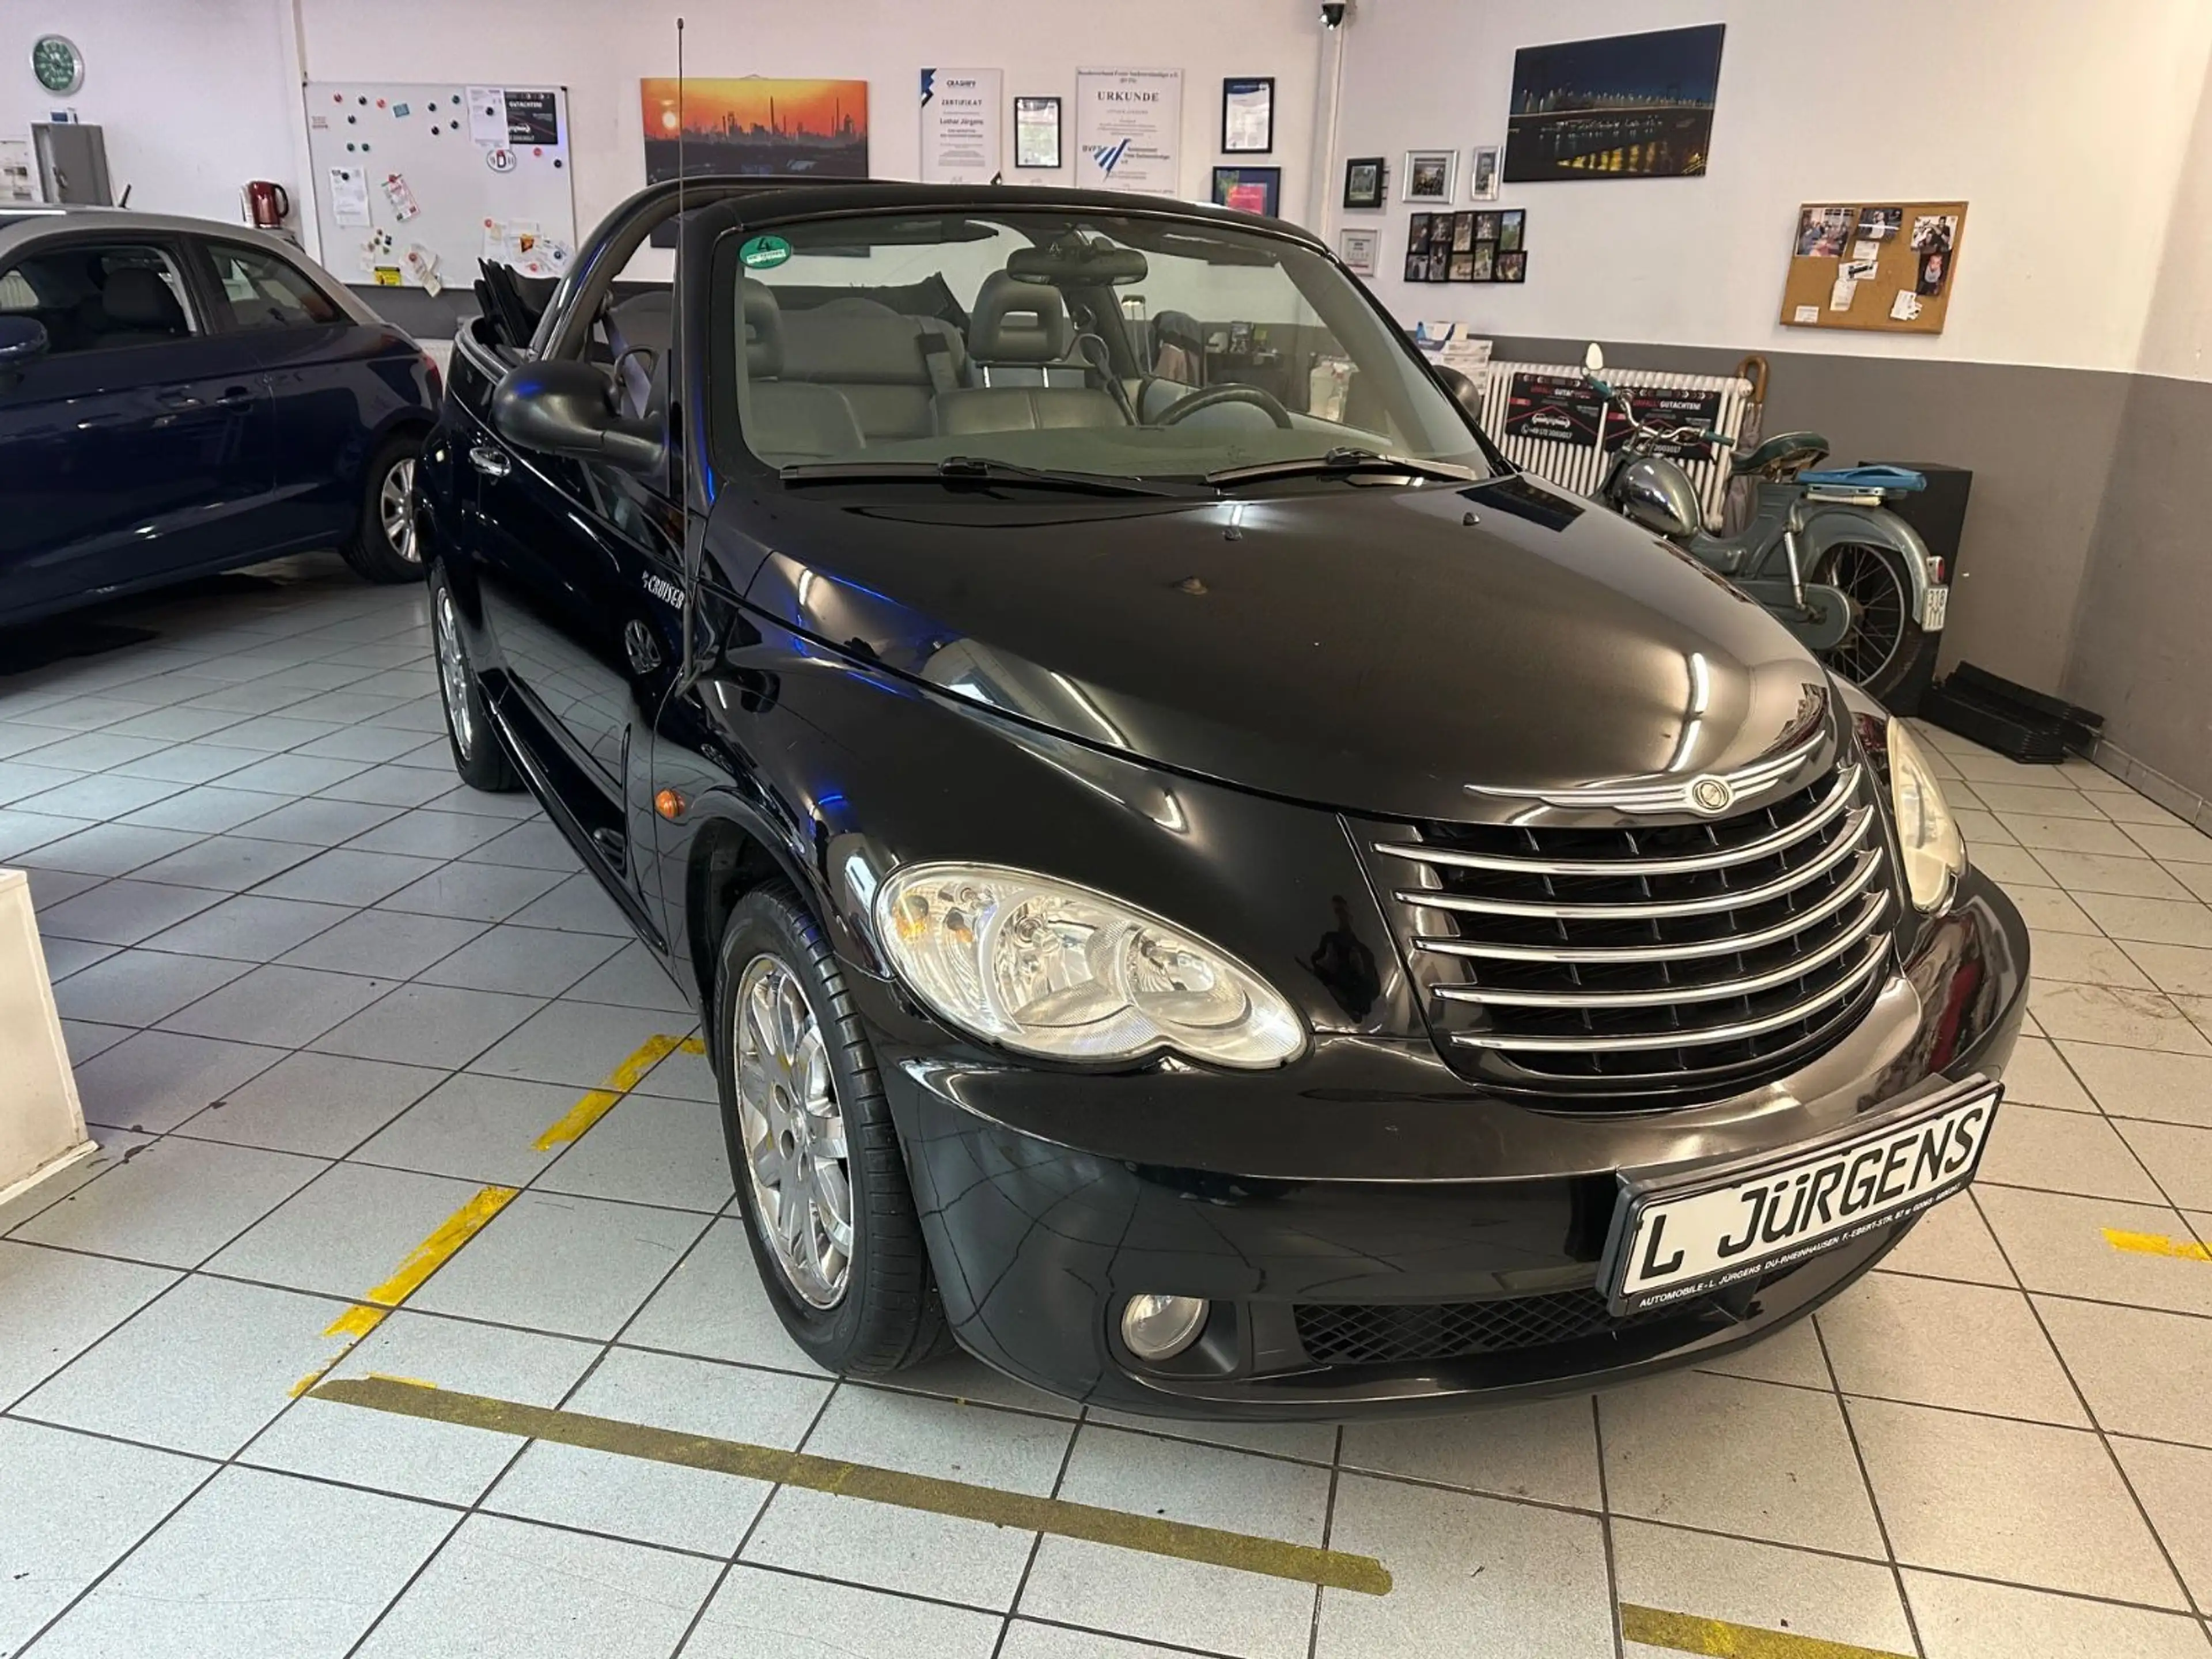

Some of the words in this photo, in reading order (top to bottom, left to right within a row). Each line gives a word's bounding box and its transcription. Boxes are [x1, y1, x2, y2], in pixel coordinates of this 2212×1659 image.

[1097, 91, 1159, 102] URKUNDE
[647, 575, 685, 609] CRUISER
[1639, 1214, 1685, 1281] L
[1717, 1107, 1983, 1259] JÜRGENS
[1718, 1264, 1761, 1285] JÜRGENS
